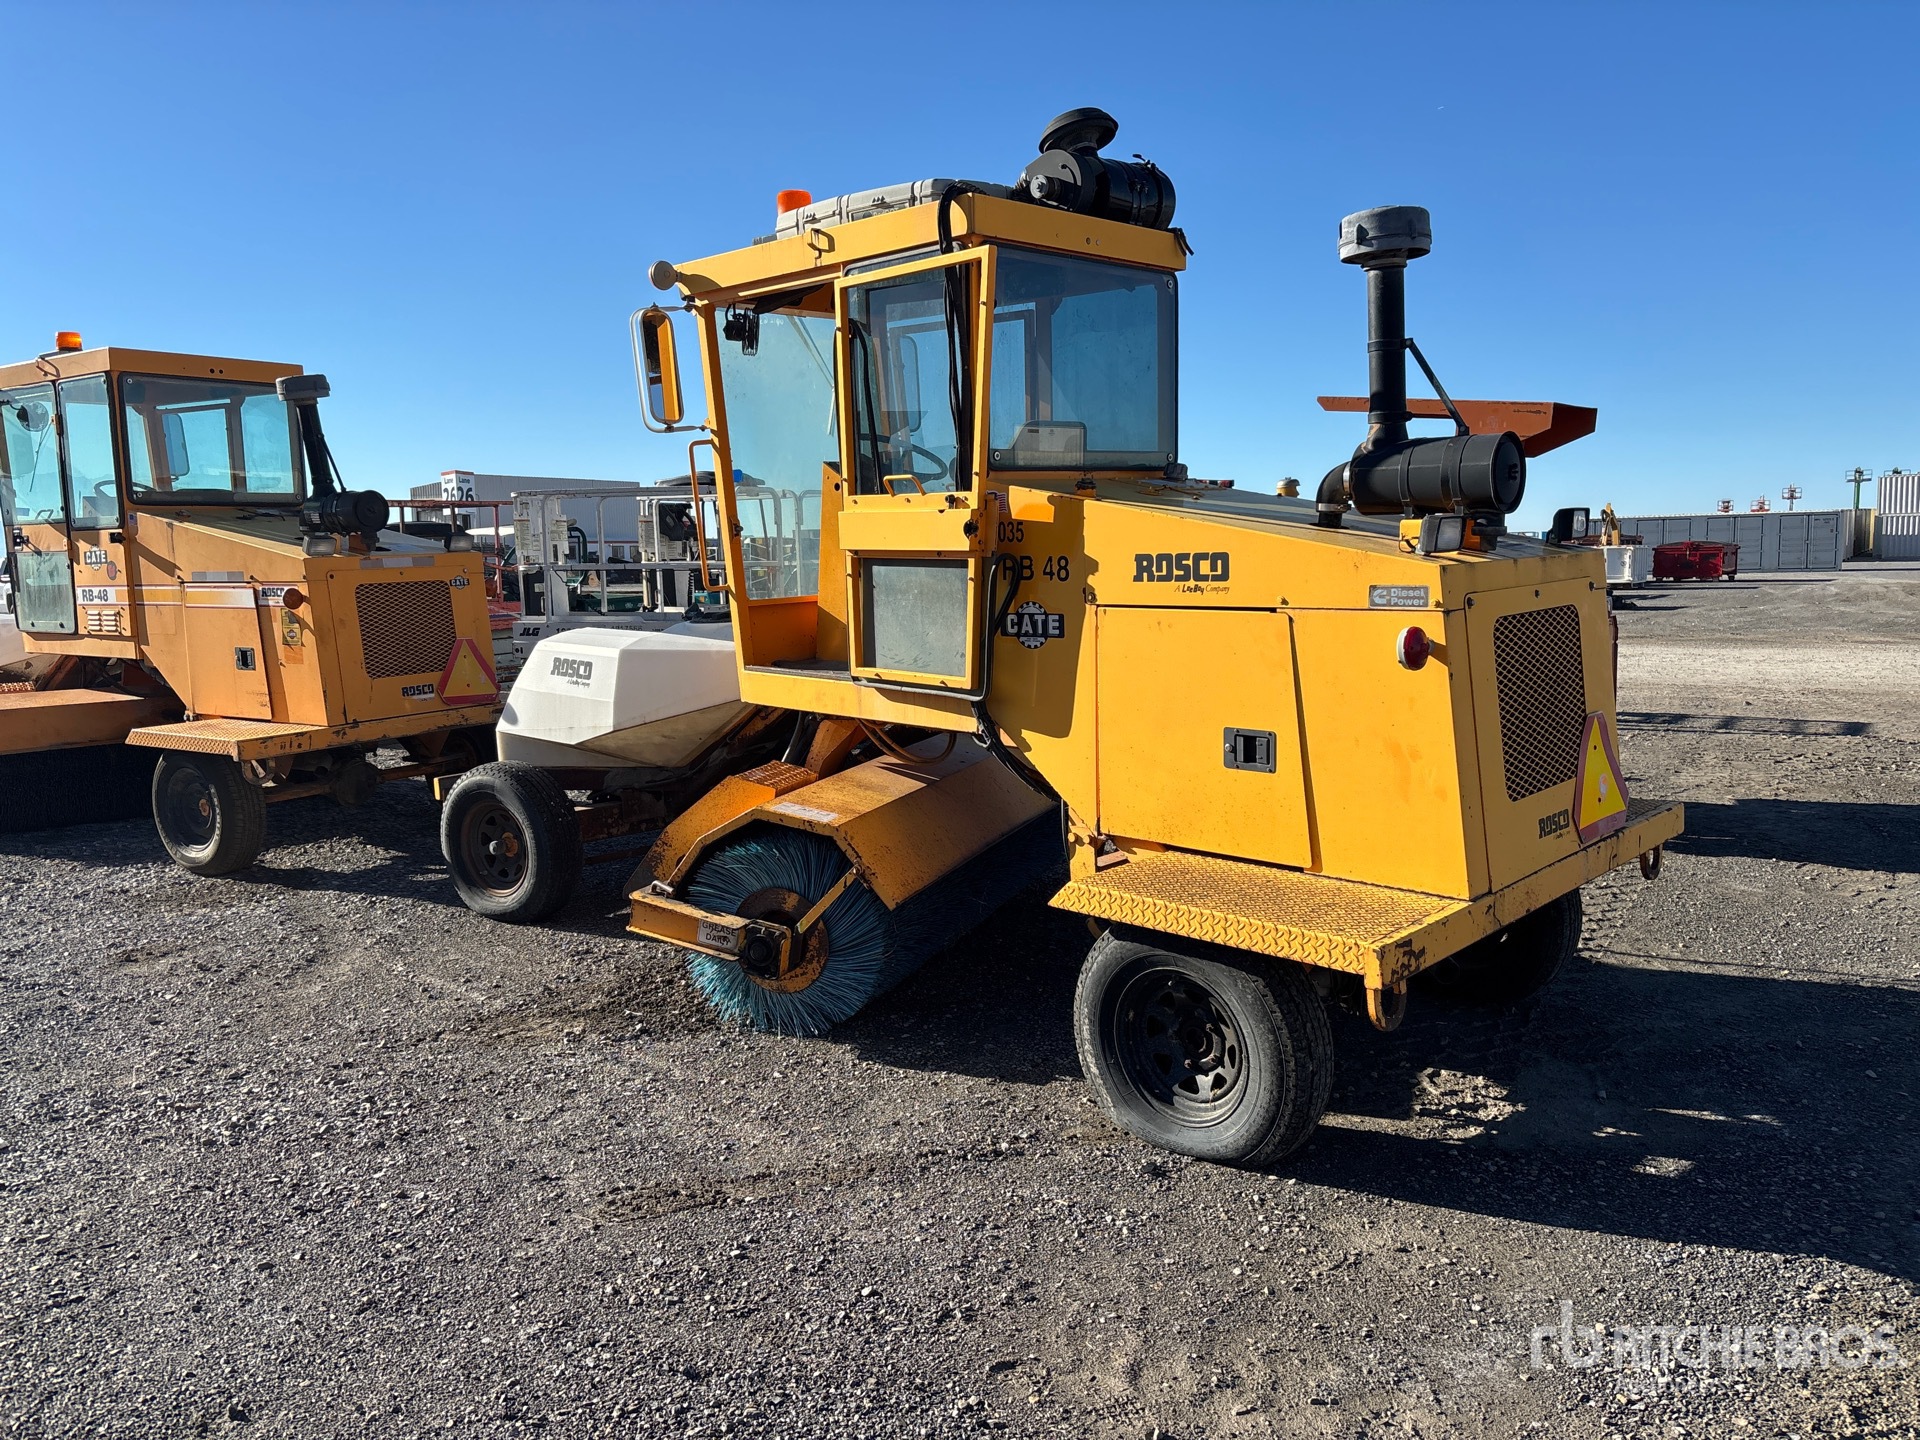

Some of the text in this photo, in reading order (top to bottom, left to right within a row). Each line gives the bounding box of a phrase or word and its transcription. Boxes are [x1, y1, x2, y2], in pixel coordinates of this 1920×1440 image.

[457, 485, 475, 501] 26
[85, 551, 106, 563] CATE
[1042, 555, 1070, 582] 48
[1132, 552, 1230, 582] ROSCO
[450, 578, 469, 586] CATE
[81, 588, 109, 602] RB-48
[1174, 584, 1230, 595] A LeeBoy Company
[1390, 588, 1425, 597] Diesel
[1390, 597, 1425, 606] Power
[1007, 614, 1060, 635] CATE
[519, 627, 541, 637] JLG
[550, 656, 593, 681] ROSCO
[401, 683, 435, 697] ROSCO
[1538, 808, 1570, 840] ROSCO
[702, 921, 738, 937] GREASE
